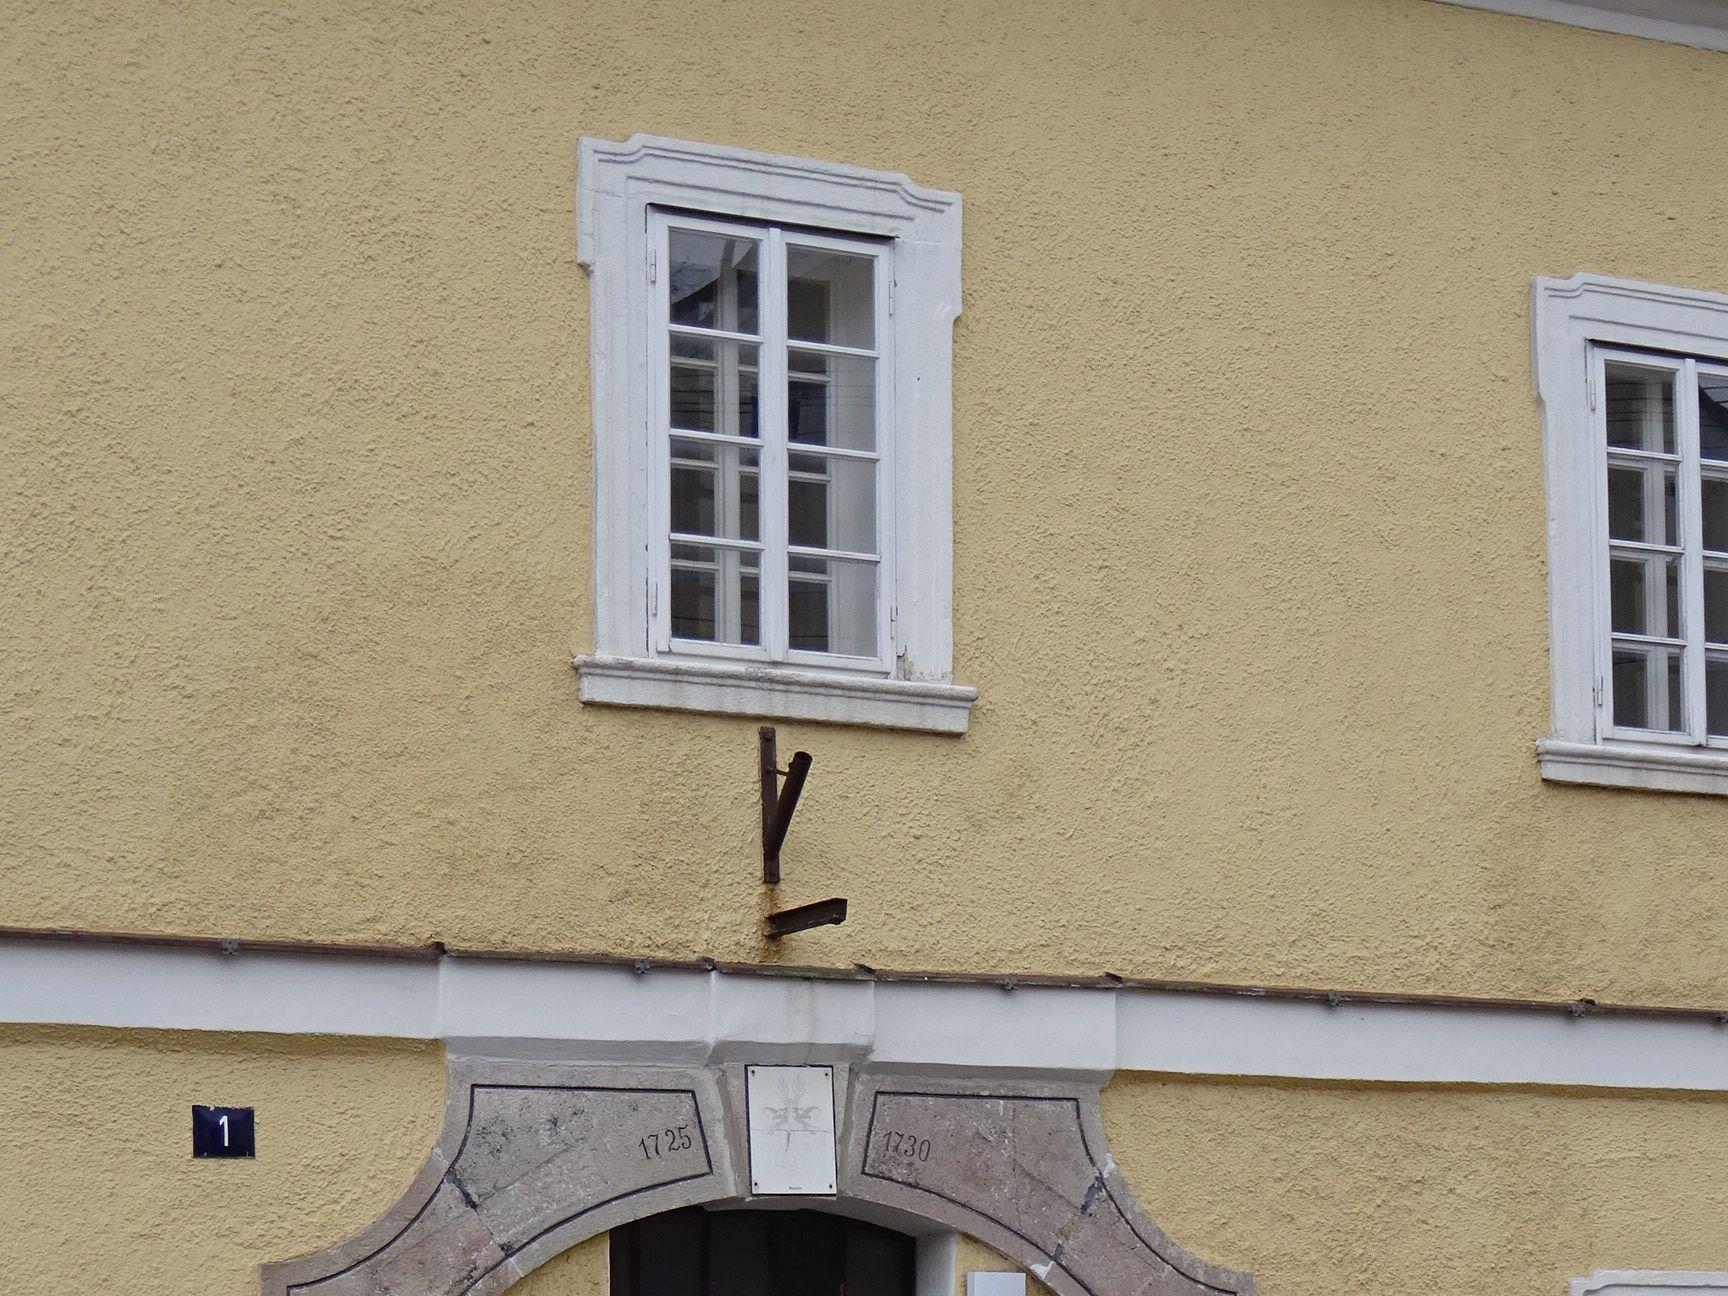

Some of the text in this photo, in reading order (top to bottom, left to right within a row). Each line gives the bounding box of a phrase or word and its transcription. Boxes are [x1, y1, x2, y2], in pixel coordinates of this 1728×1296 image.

[219, 1115, 229, 1147] 1
[638, 1124, 692, 1160] 1725
[883, 1130, 931, 1162] 1730
